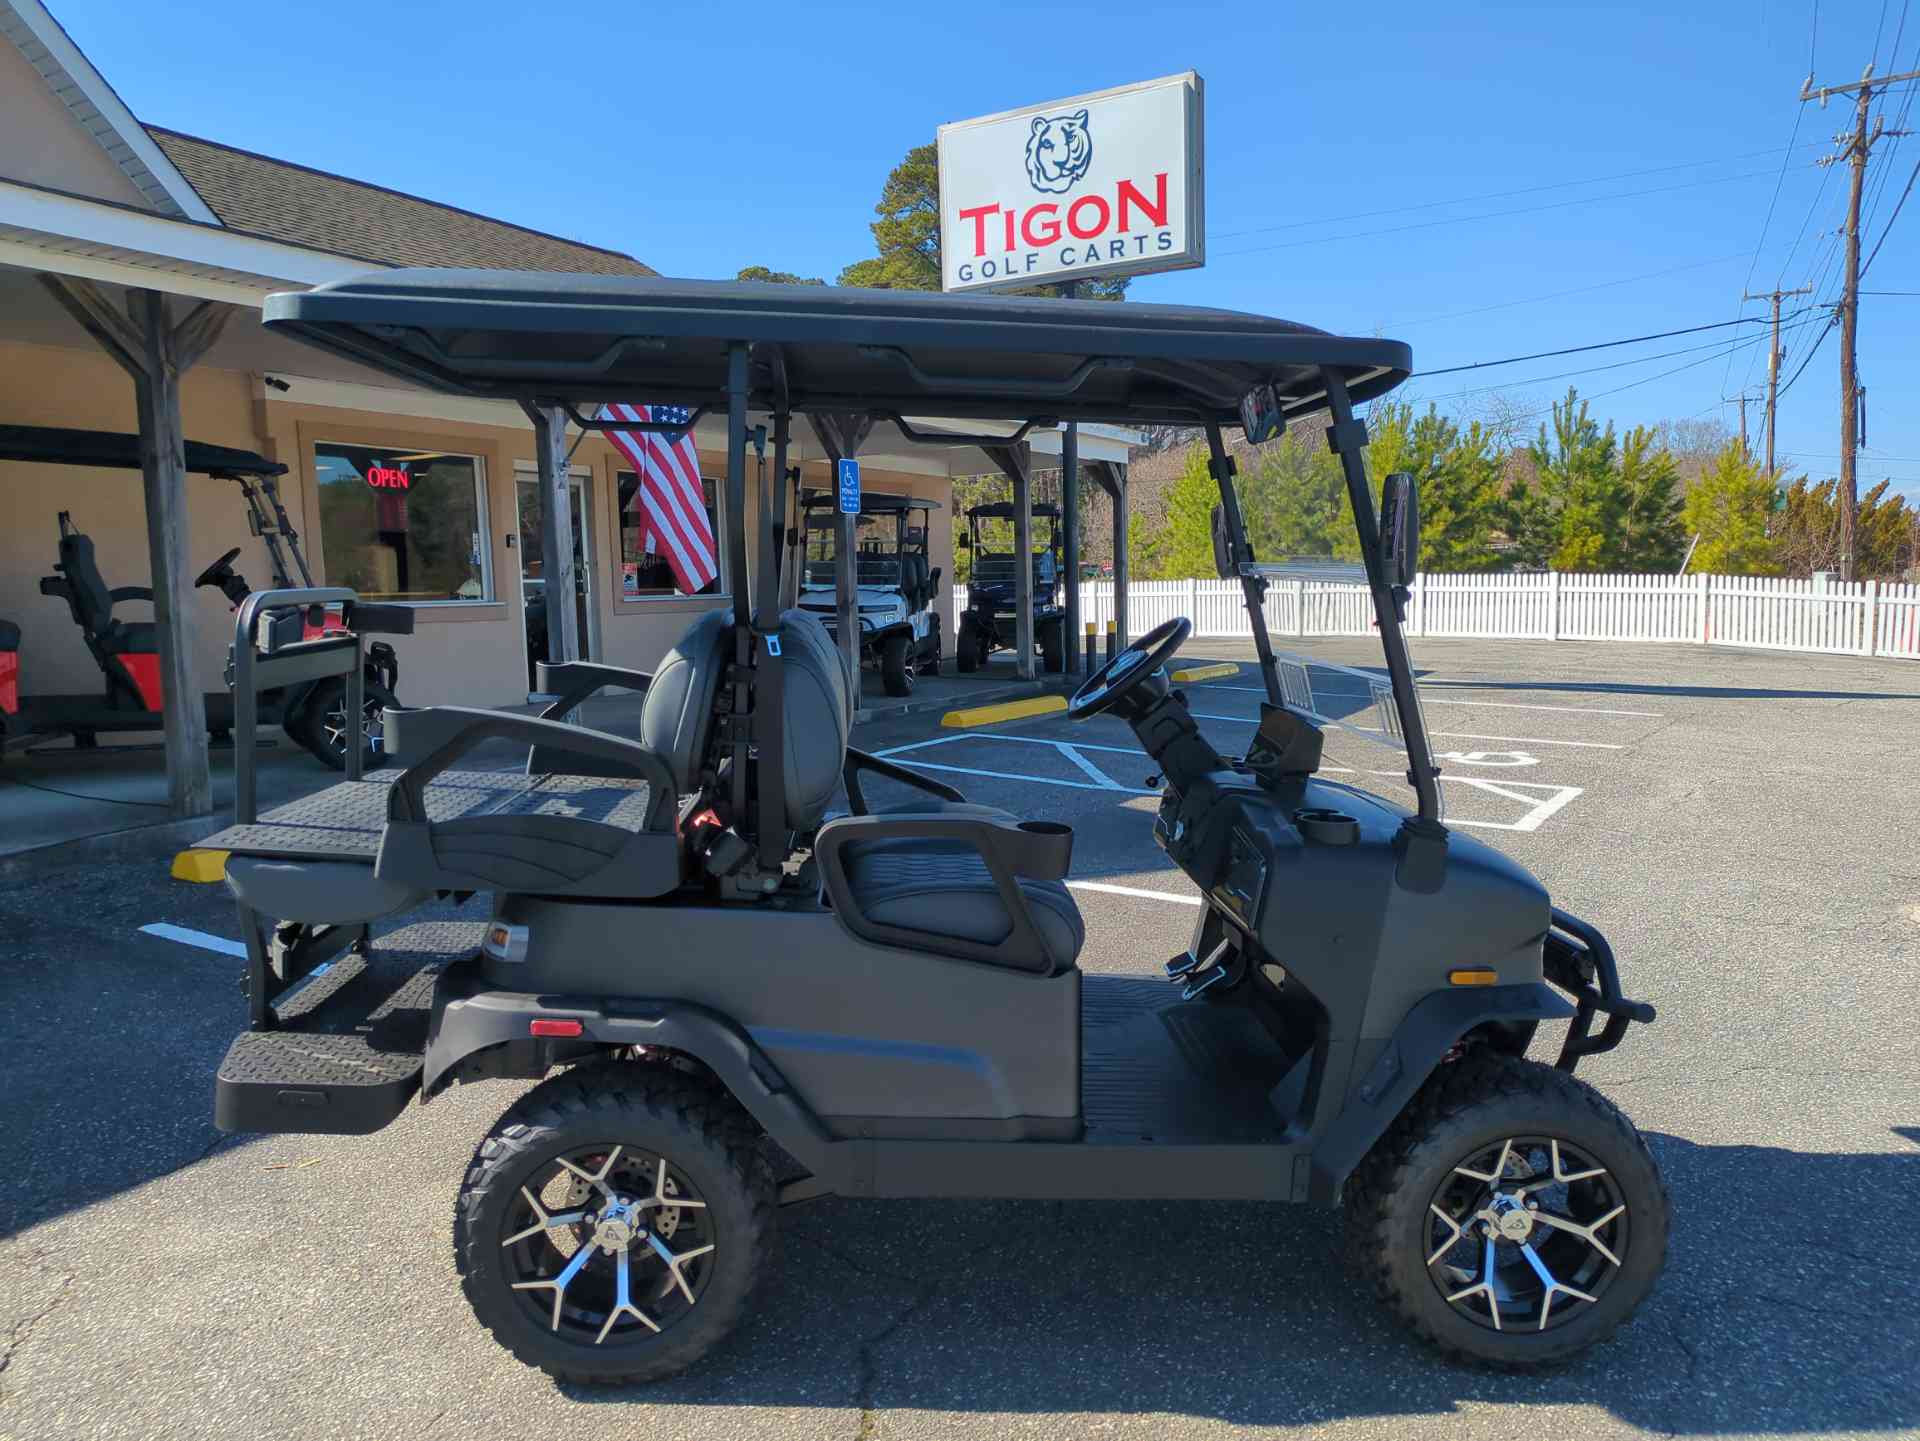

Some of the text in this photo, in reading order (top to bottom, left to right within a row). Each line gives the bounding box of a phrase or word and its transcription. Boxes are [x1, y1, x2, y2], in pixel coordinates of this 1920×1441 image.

[959, 173, 1169, 257] TIGON
[958, 231, 1173, 282] GOLF CARTS
[368, 467, 409, 489] OPEN
